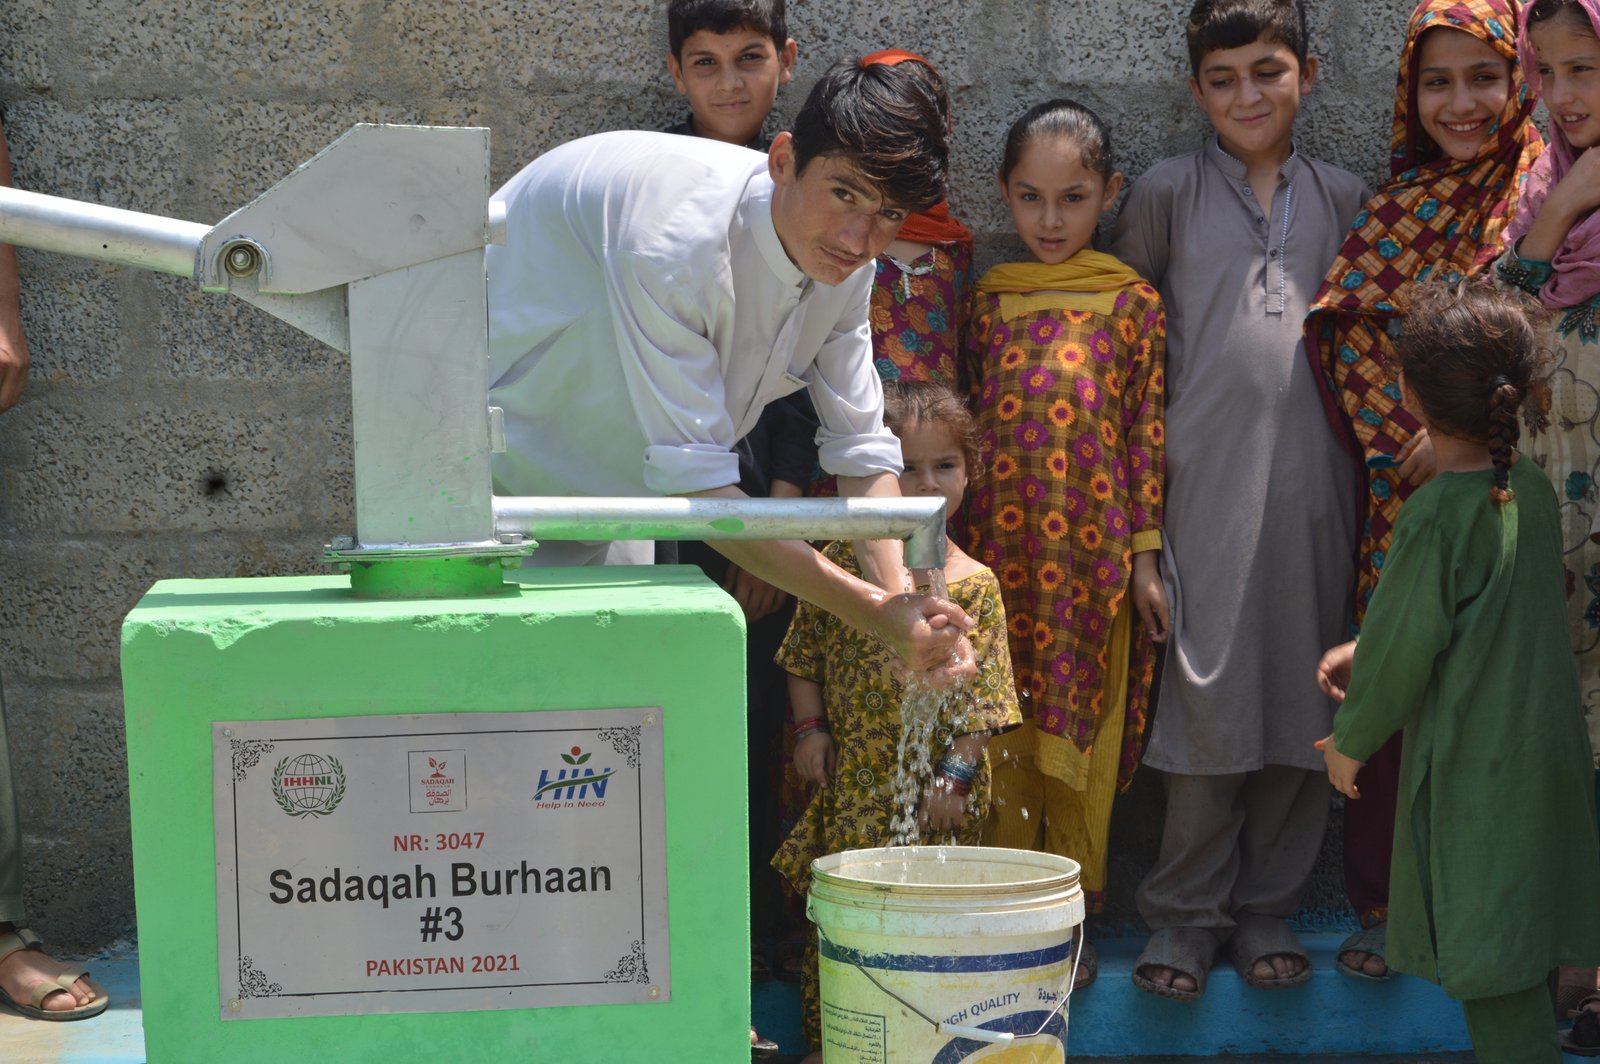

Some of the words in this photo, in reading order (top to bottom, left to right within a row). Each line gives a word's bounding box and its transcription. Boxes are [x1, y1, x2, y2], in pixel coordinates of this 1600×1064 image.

[284, 776, 334, 787] IHHNL
[536, 802, 561, 810] Help
[577, 800, 606, 808] Need
[393, 833, 430, 853] NR:
[435, 831, 486, 851] 3047
[269, 863, 437, 909] Sadaqah
[451, 860, 612, 897] Burhaan
[420, 906, 465, 943] #3
[365, 957, 465, 978] PAKISTAN
[472, 954, 521, 975] 2021
[970, 992, 1021, 1016] QUALITY
